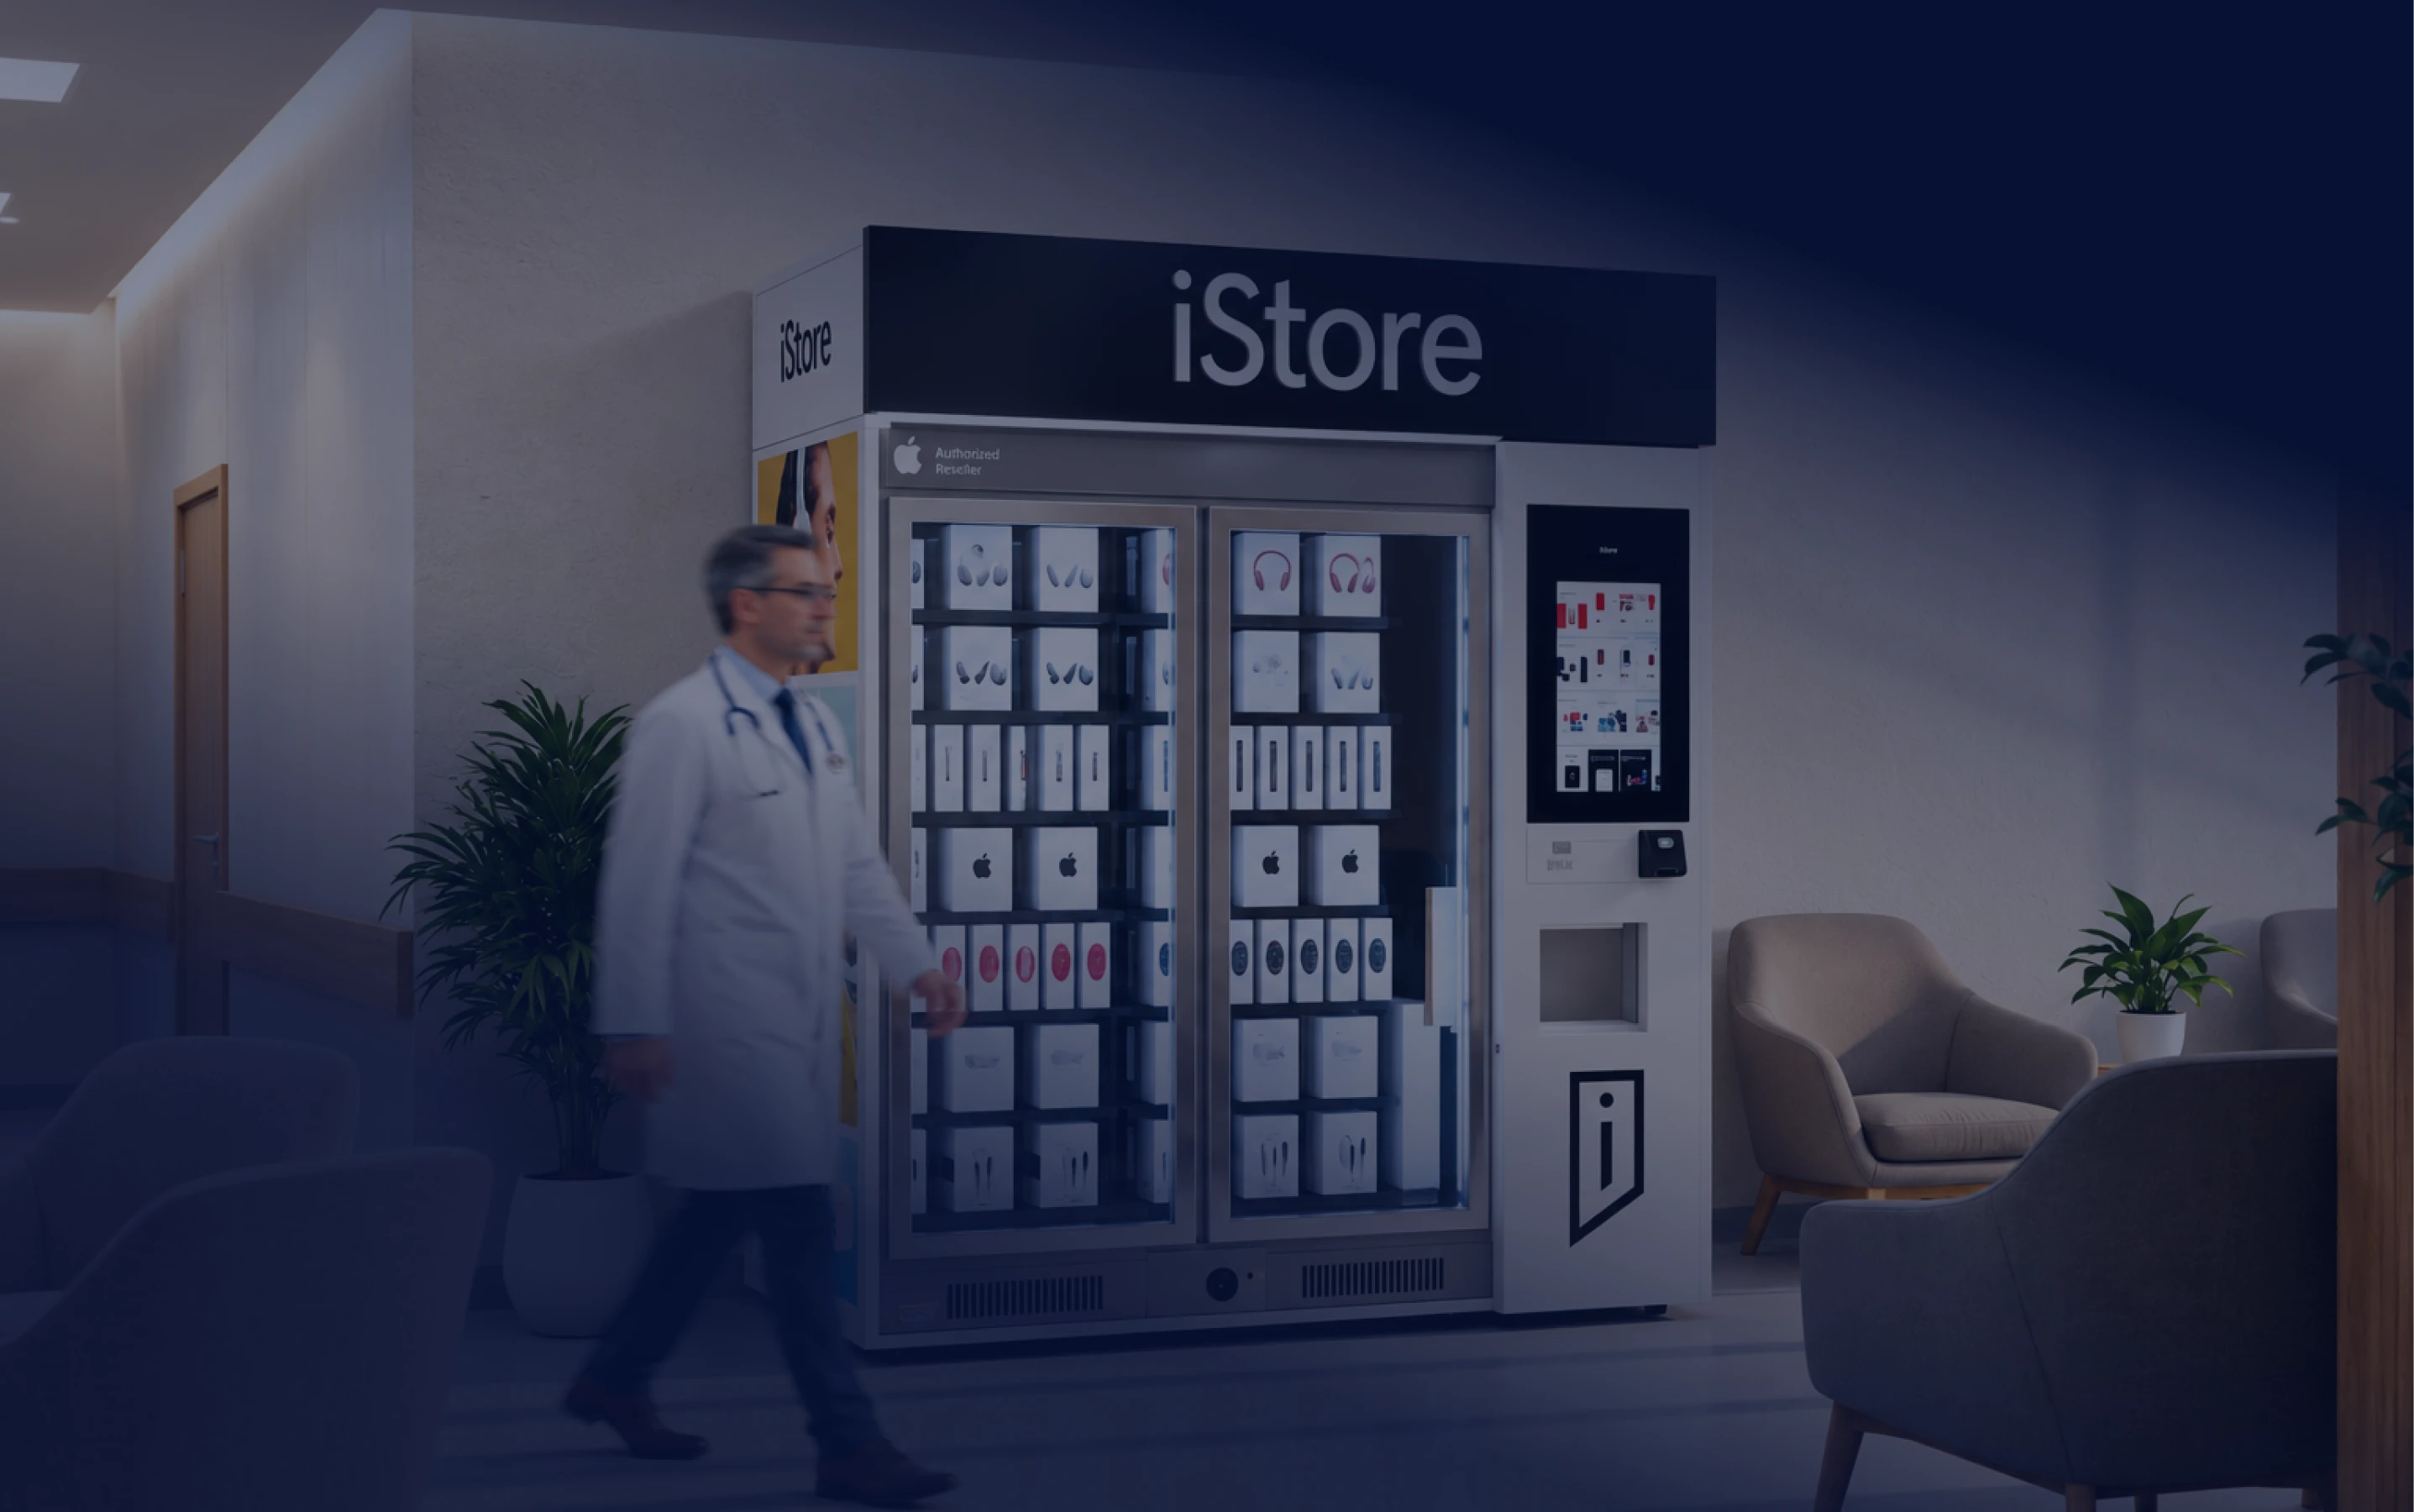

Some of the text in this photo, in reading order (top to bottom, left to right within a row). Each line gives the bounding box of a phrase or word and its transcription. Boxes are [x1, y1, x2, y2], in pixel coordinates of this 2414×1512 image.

[780, 319, 832, 382] iStore
[1171, 269, 1483, 396] iStore
[935, 447, 1000, 460] Authorized
